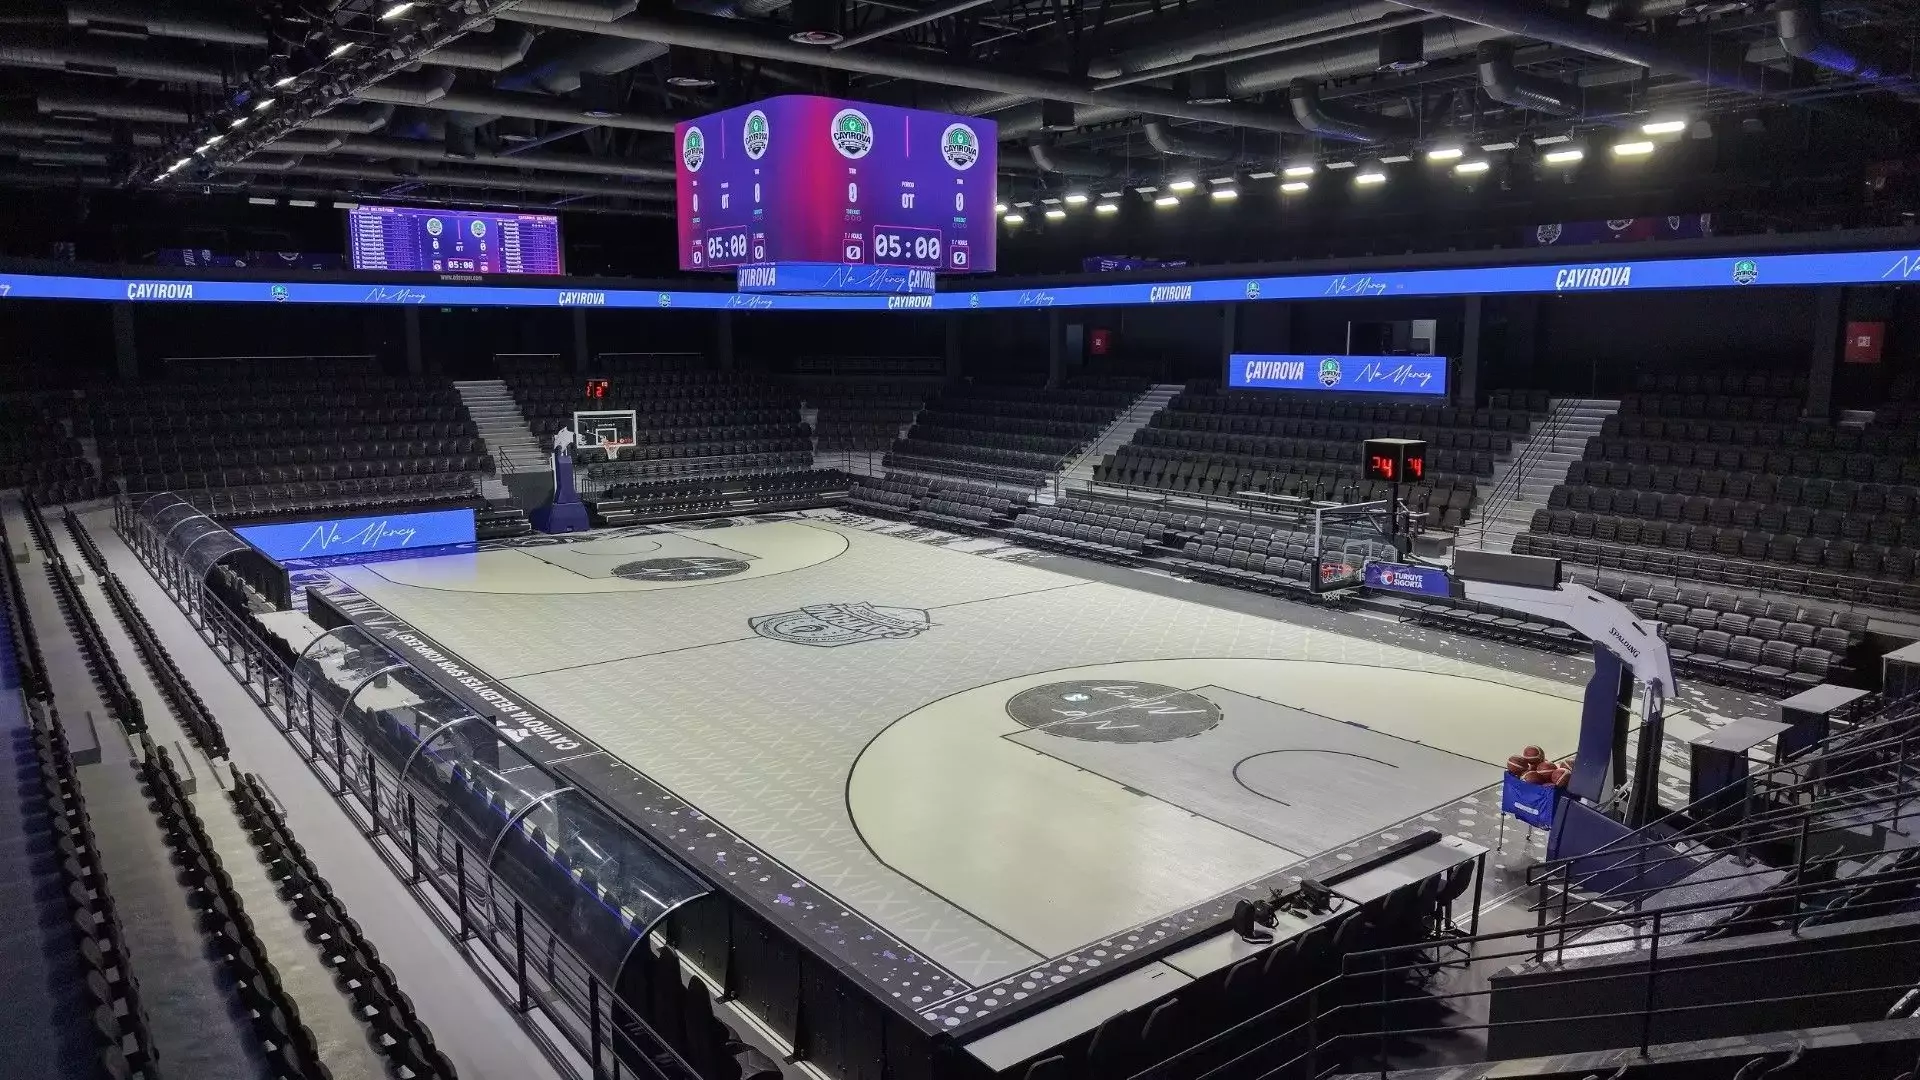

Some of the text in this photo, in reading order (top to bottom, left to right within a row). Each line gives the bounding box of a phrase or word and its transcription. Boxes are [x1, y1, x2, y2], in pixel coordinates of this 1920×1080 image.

[848, 182, 857, 203] 0
[955, 192, 964, 212] 0
[708, 233, 747, 259] 05:00
[755, 245, 764, 260] 0
[846, 245, 861, 260] 0
[875, 233, 941, 260] 05:00
[953, 251, 967, 265] 0
[823, 265, 906, 292] No Mercy
[1325, 276, 1386, 296] No Mercy
[1556, 266, 1632, 291] ÇAYIROVA
[127, 283, 194, 300] ÇAYIROVA
[559, 291, 605, 307] ÇAYIROVA
[1150, 285, 1192, 303] ÇAYIROVA
[888, 295, 933, 310] ÇAYIROVA
[1245, 360, 1305, 383] ÇAYIROVA
[1354, 362, 1433, 388] No Mercy
[300, 520, 418, 552] No Mercy
[1608, 626, 1641, 659] SPALDING
